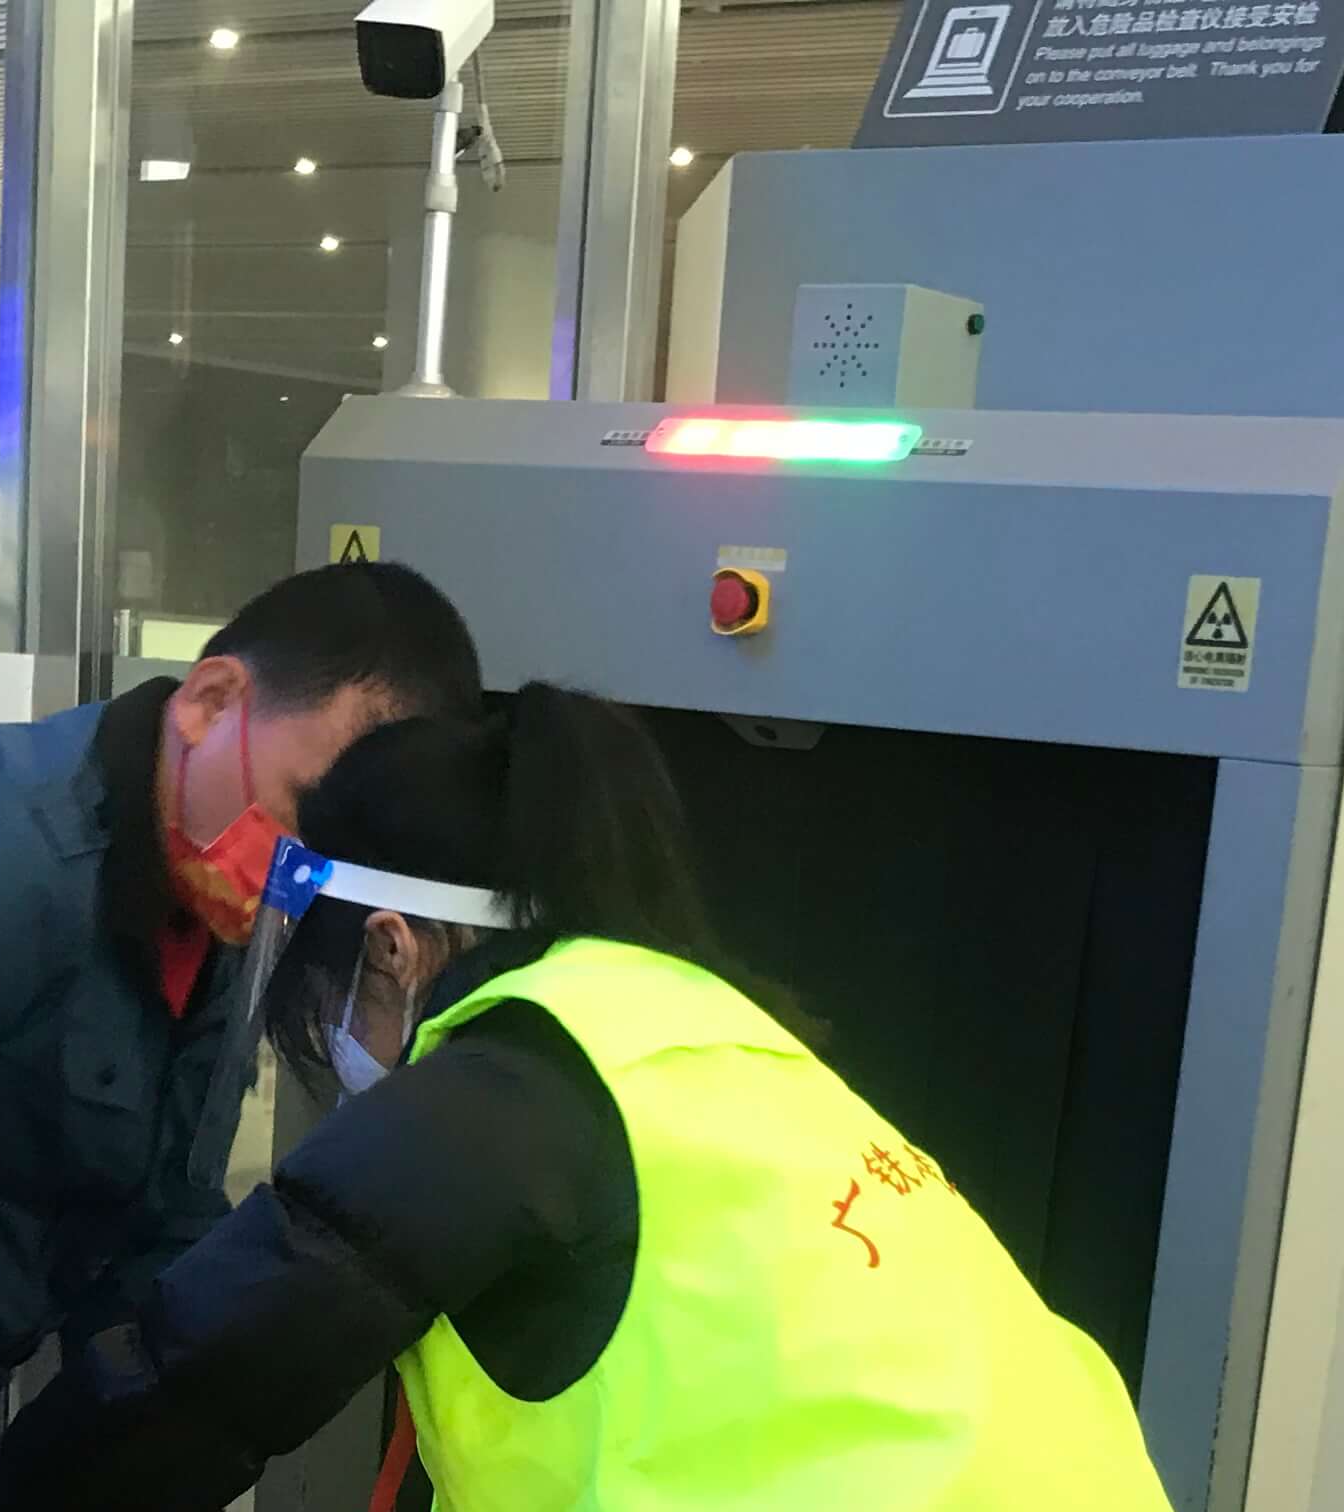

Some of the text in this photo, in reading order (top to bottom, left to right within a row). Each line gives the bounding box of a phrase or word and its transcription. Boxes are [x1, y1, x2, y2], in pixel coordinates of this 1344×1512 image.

[1094, 67, 1165, 83] conveyor
[1210, 61, 1258, 77] Thank
[1258, 62, 1294, 78] you
[1016, 94, 1051, 111] your
